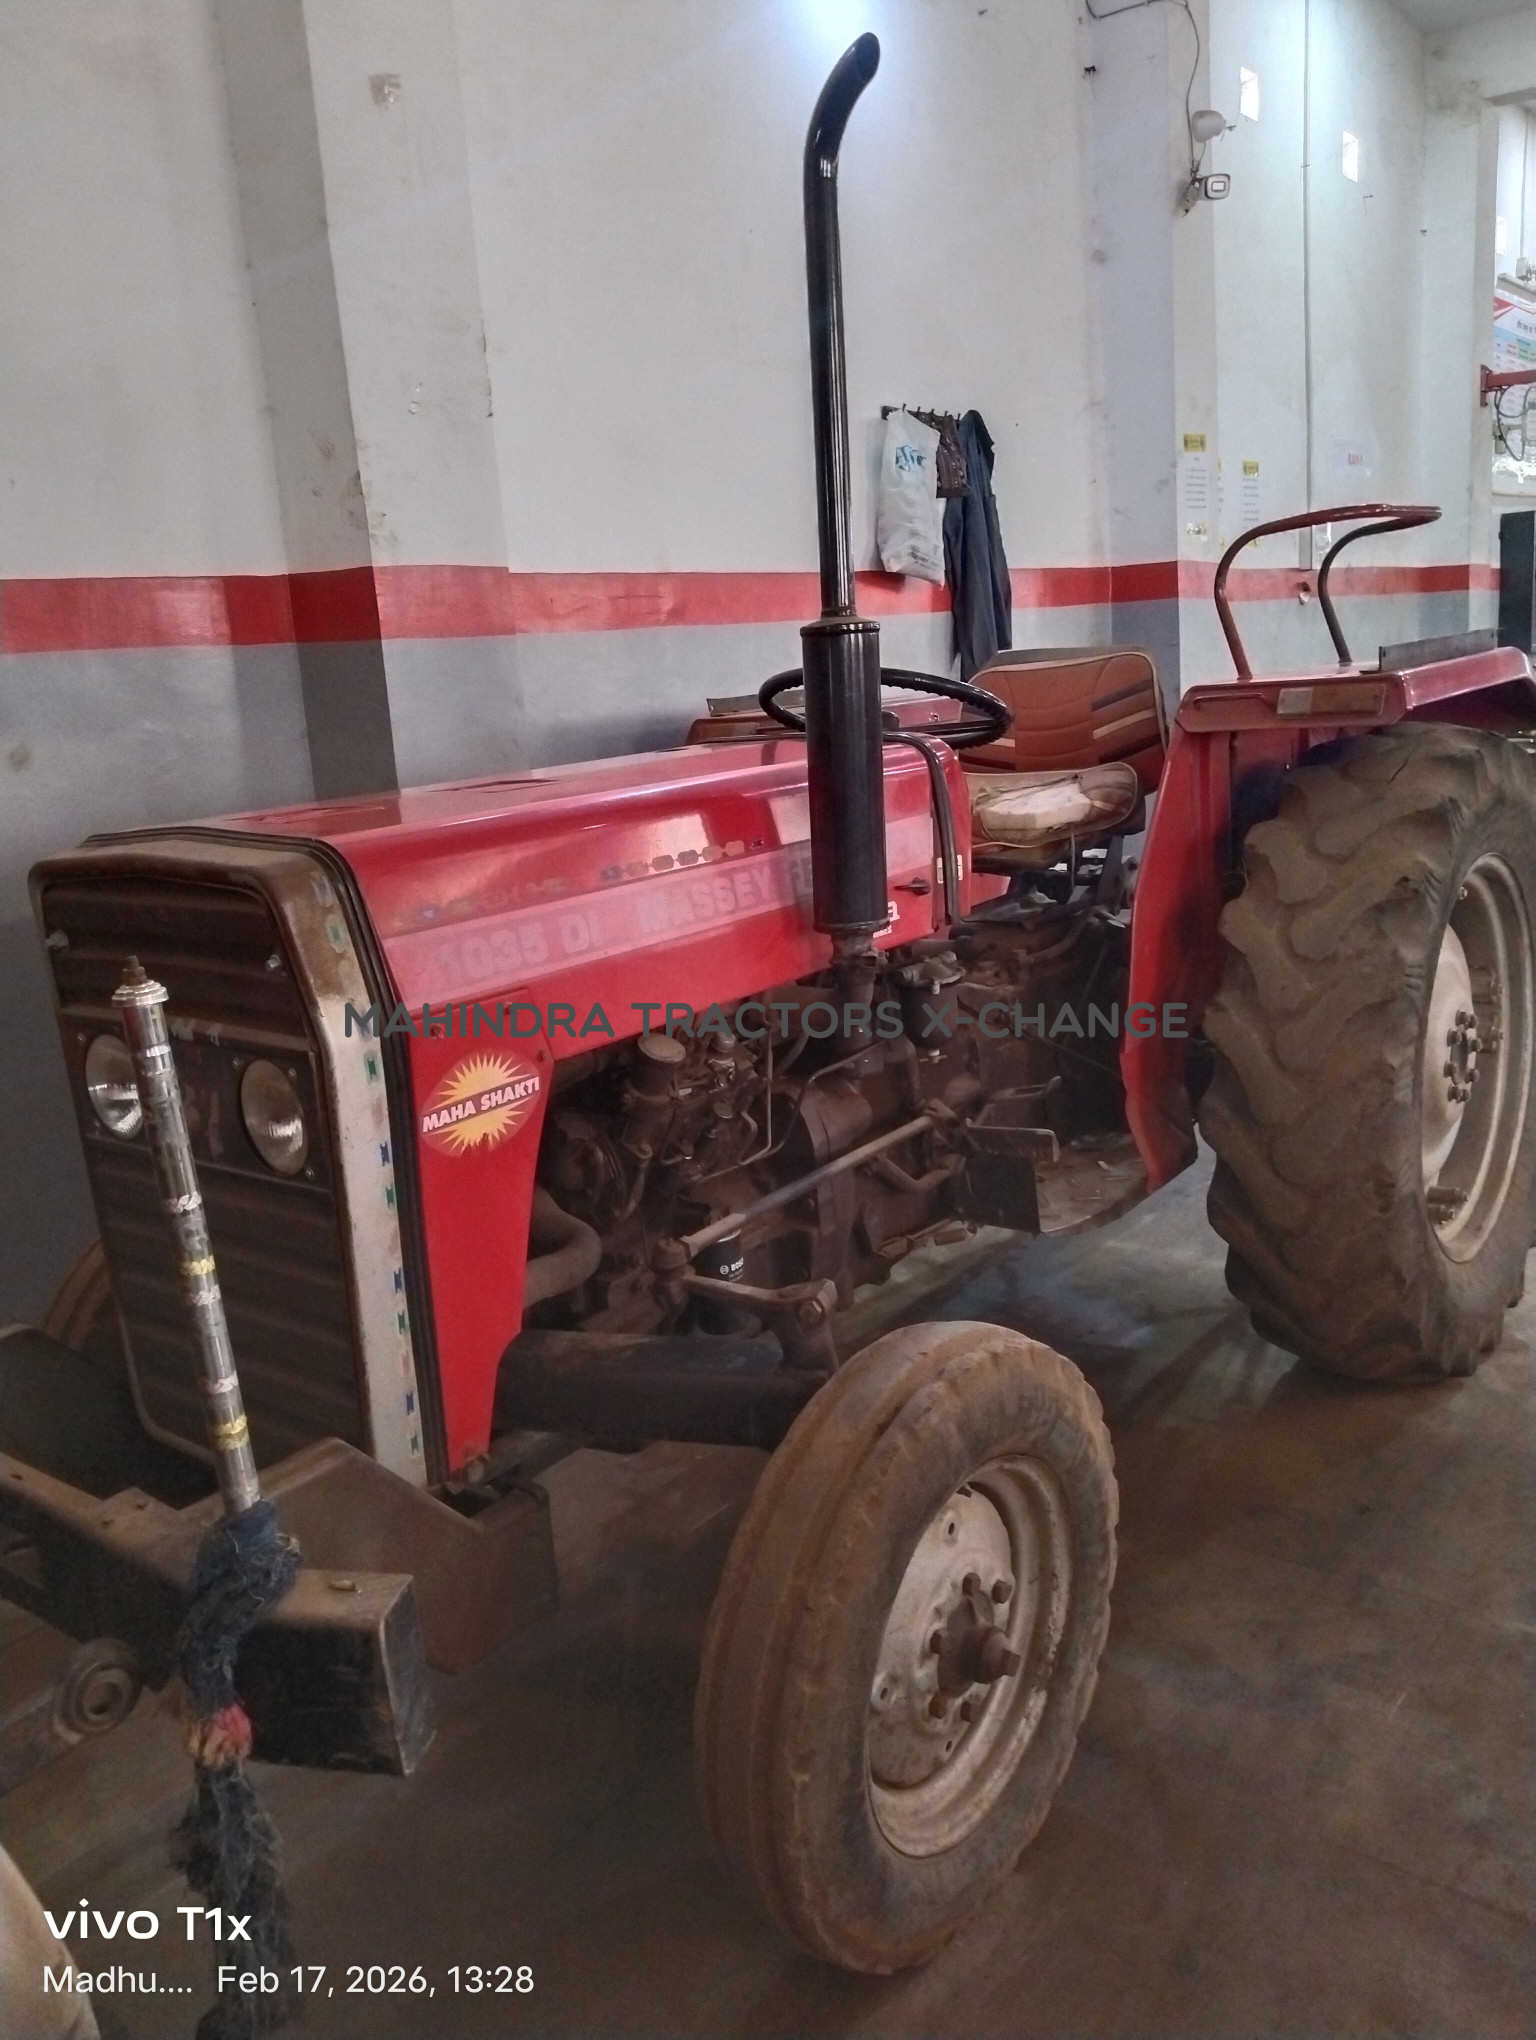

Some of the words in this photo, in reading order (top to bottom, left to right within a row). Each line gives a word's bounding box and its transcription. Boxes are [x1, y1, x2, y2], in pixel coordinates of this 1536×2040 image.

[437, 922, 548, 983] 1035
[635, 865, 775, 933] MASSEY
[423, 1100, 476, 1132] MAHA
[480, 1076, 539, 1111] SHAKTI
